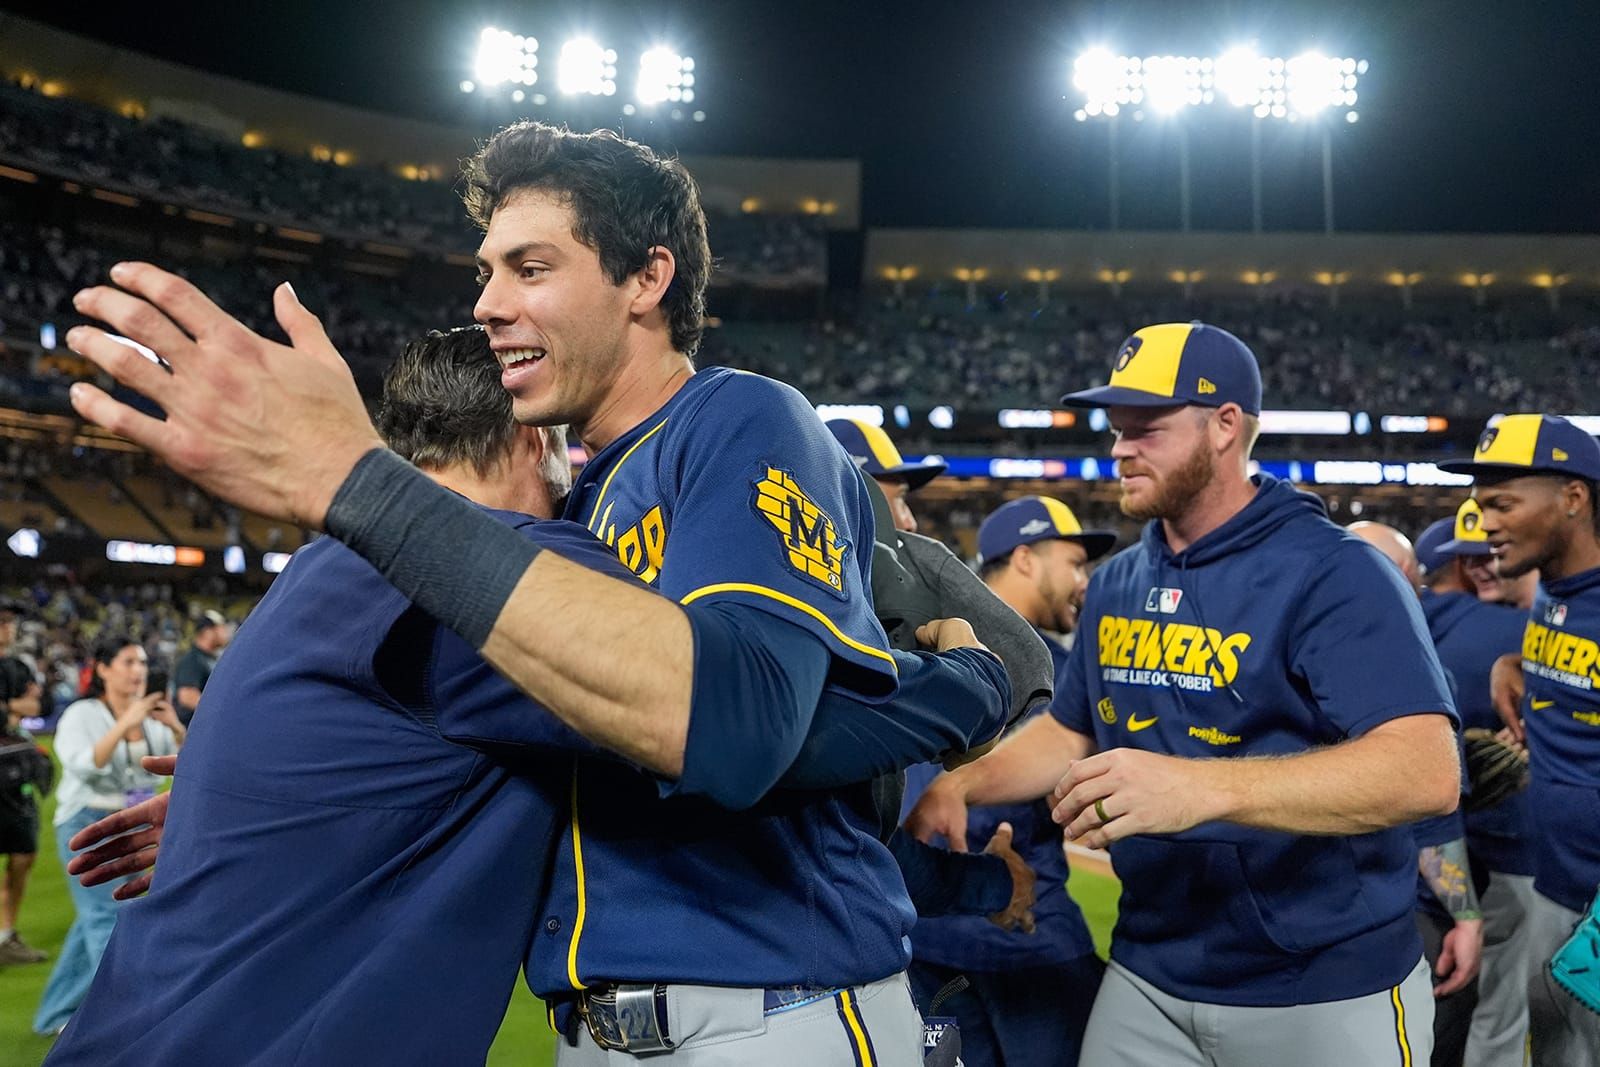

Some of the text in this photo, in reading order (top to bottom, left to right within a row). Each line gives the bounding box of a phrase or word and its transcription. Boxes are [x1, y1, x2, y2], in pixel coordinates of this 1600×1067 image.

[786, 495, 833, 568] M
[1098, 615, 1252, 688] BREWERS
[1151, 671, 1212, 692] OCTOBER
[621, 1007, 653, 1040] 22
